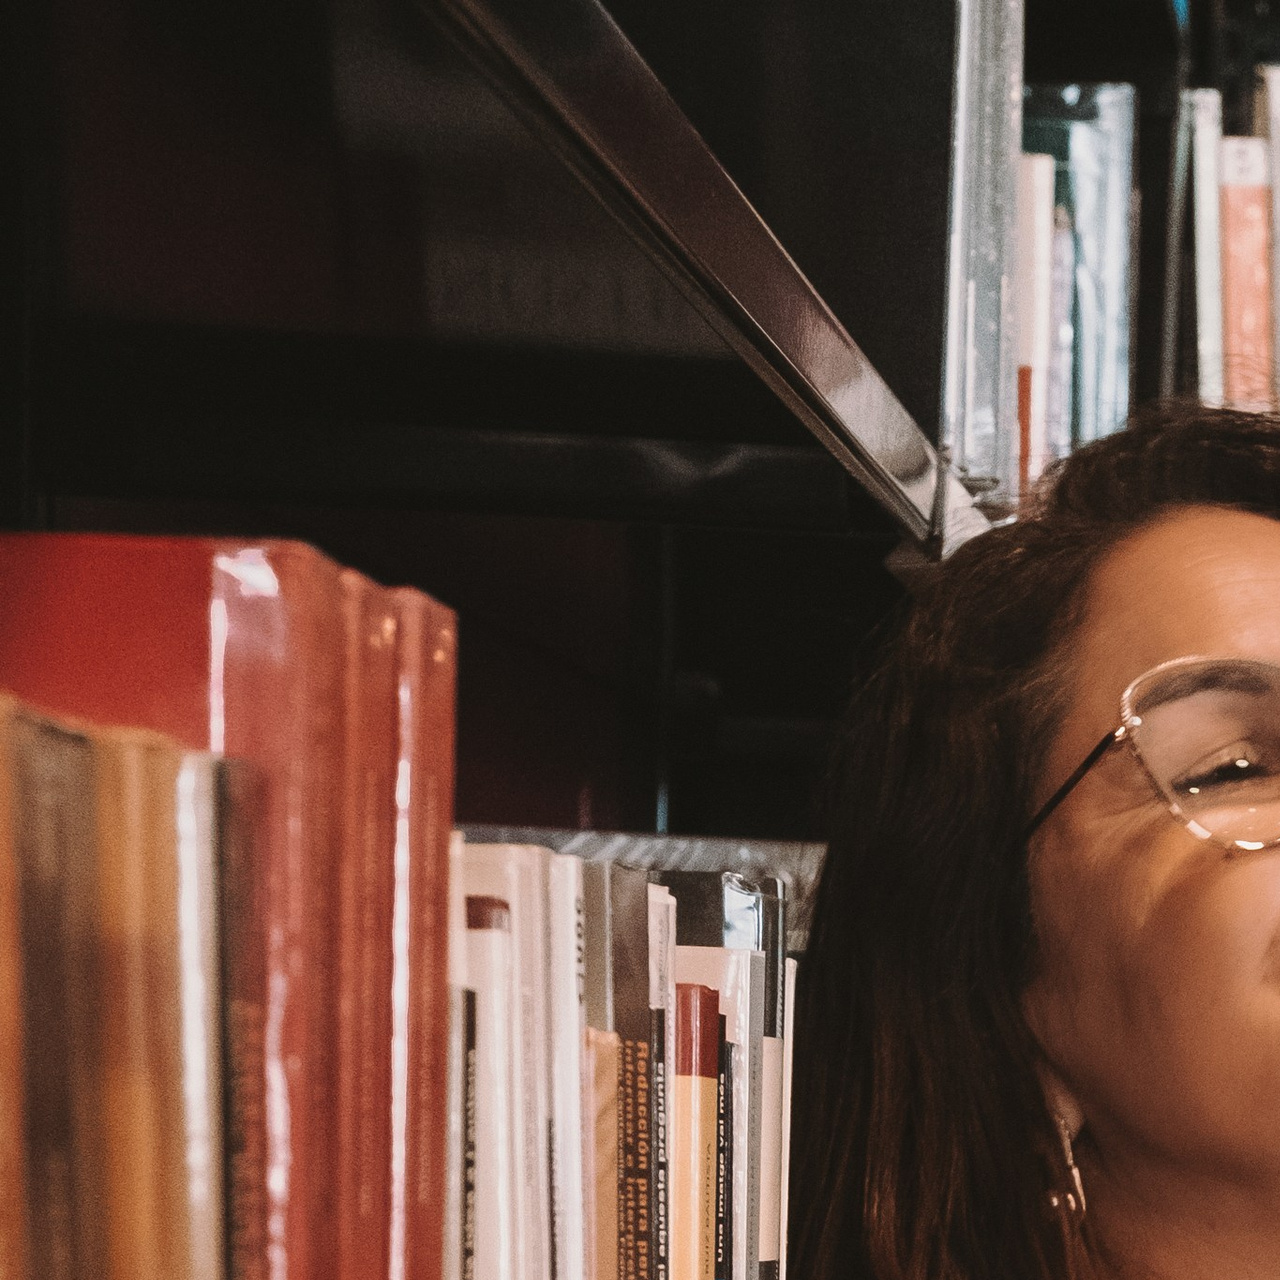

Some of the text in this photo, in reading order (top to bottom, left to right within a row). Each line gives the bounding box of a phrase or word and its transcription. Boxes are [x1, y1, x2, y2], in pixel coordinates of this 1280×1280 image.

[637, 1041, 650, 1170] Redacción
[656, 1061, 666, 1162] pregunta
[718, 1073, 726, 1114] més
[717, 1119, 725, 1148] val
[635, 1178, 648, 1232] para
[656, 1169, 667, 1257] aquesta
[716, 1224, 724, 1263] Una
